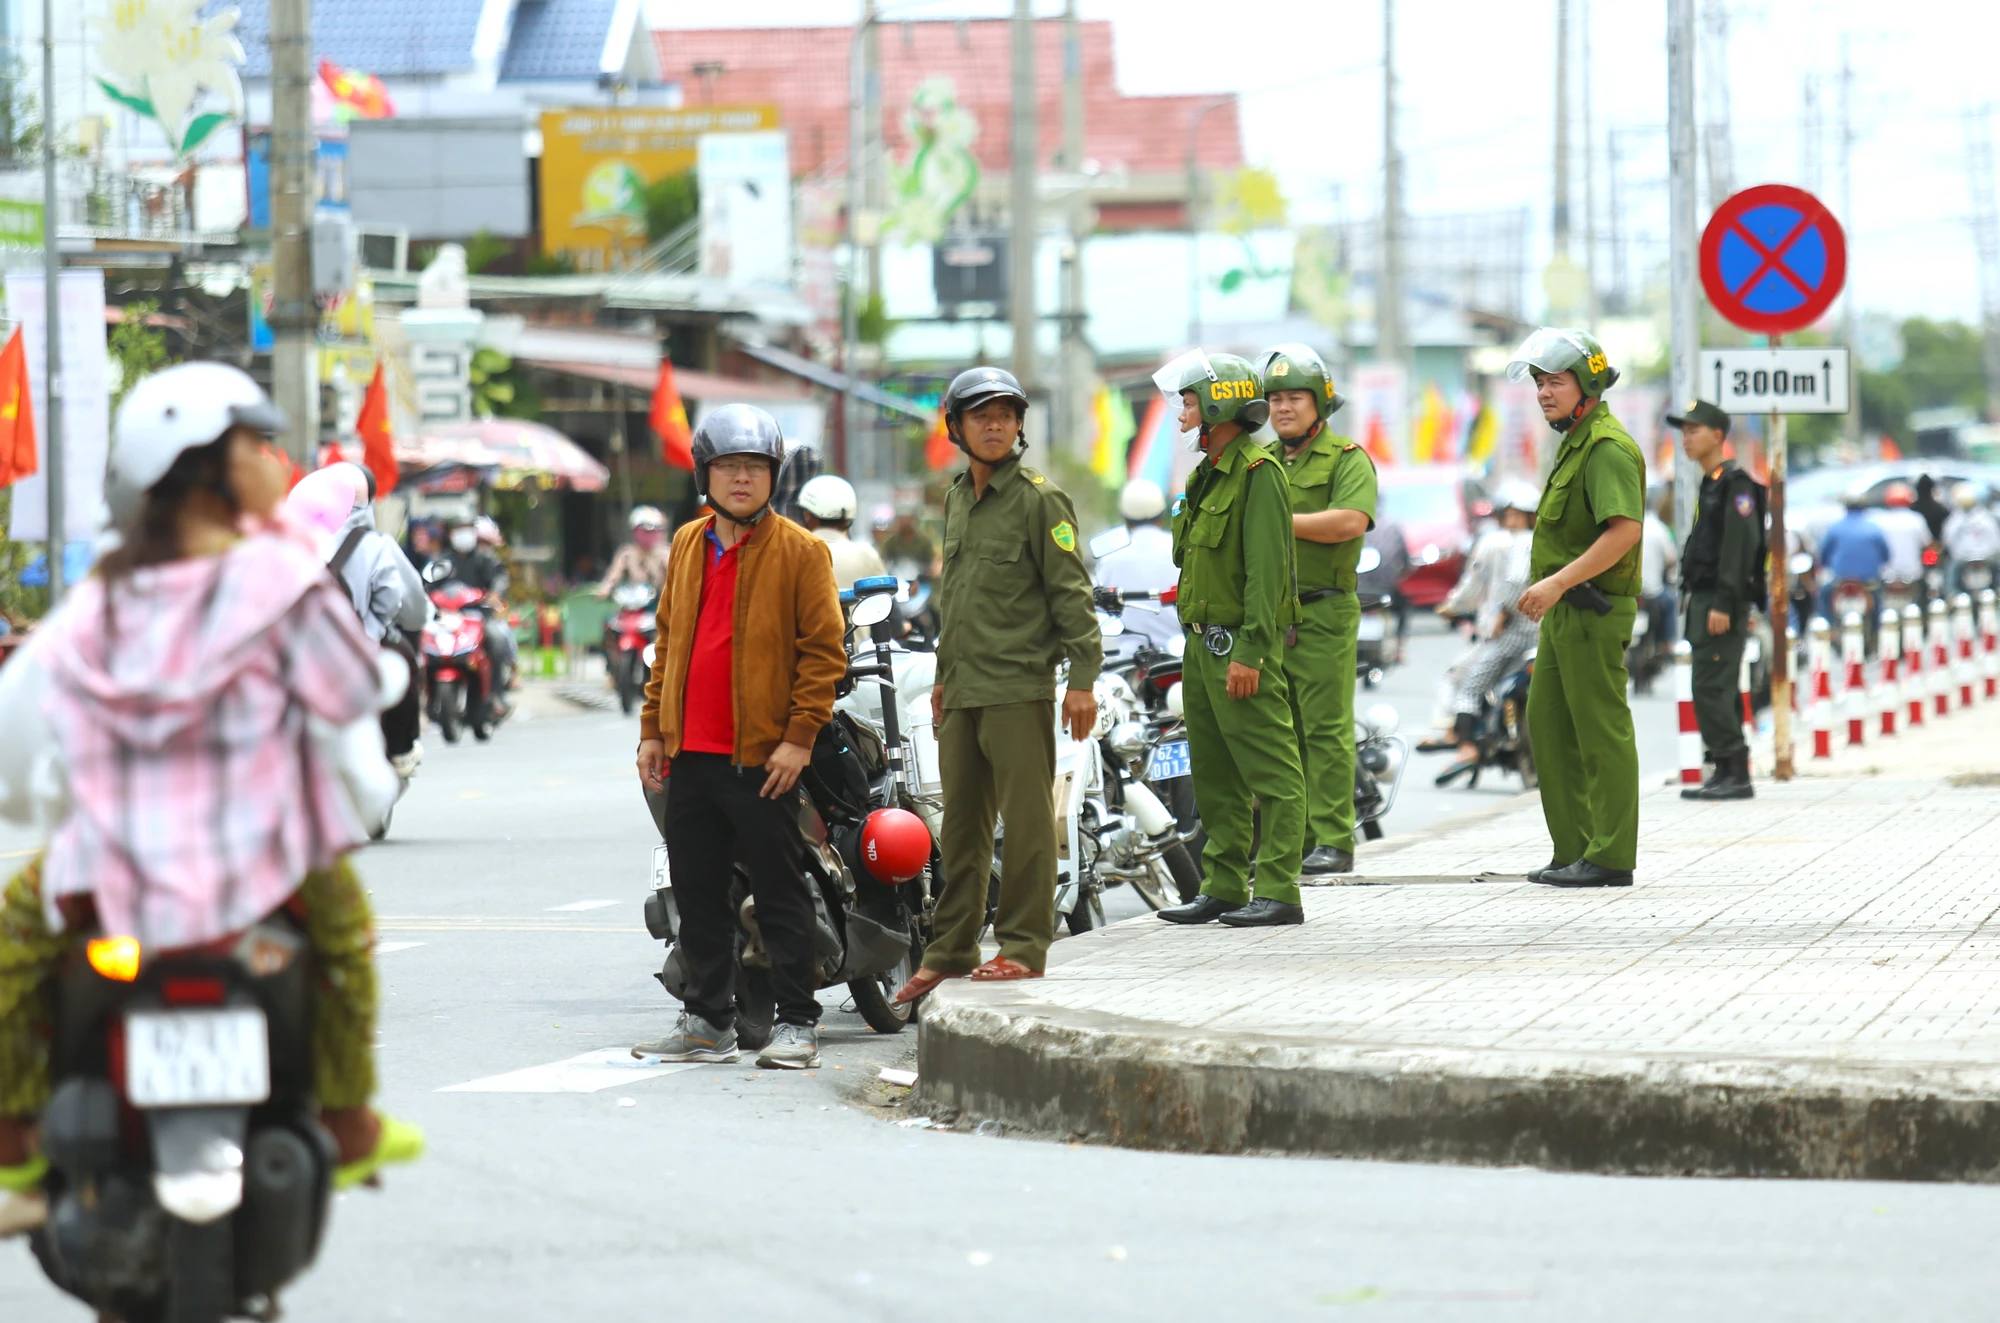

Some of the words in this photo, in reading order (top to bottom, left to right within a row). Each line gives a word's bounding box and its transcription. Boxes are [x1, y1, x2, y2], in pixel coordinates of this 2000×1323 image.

[1210, 380, 1255, 400] CS113
[1733, 370, 1815, 395] 300m
[1157, 743, 1189, 762] 62-A
